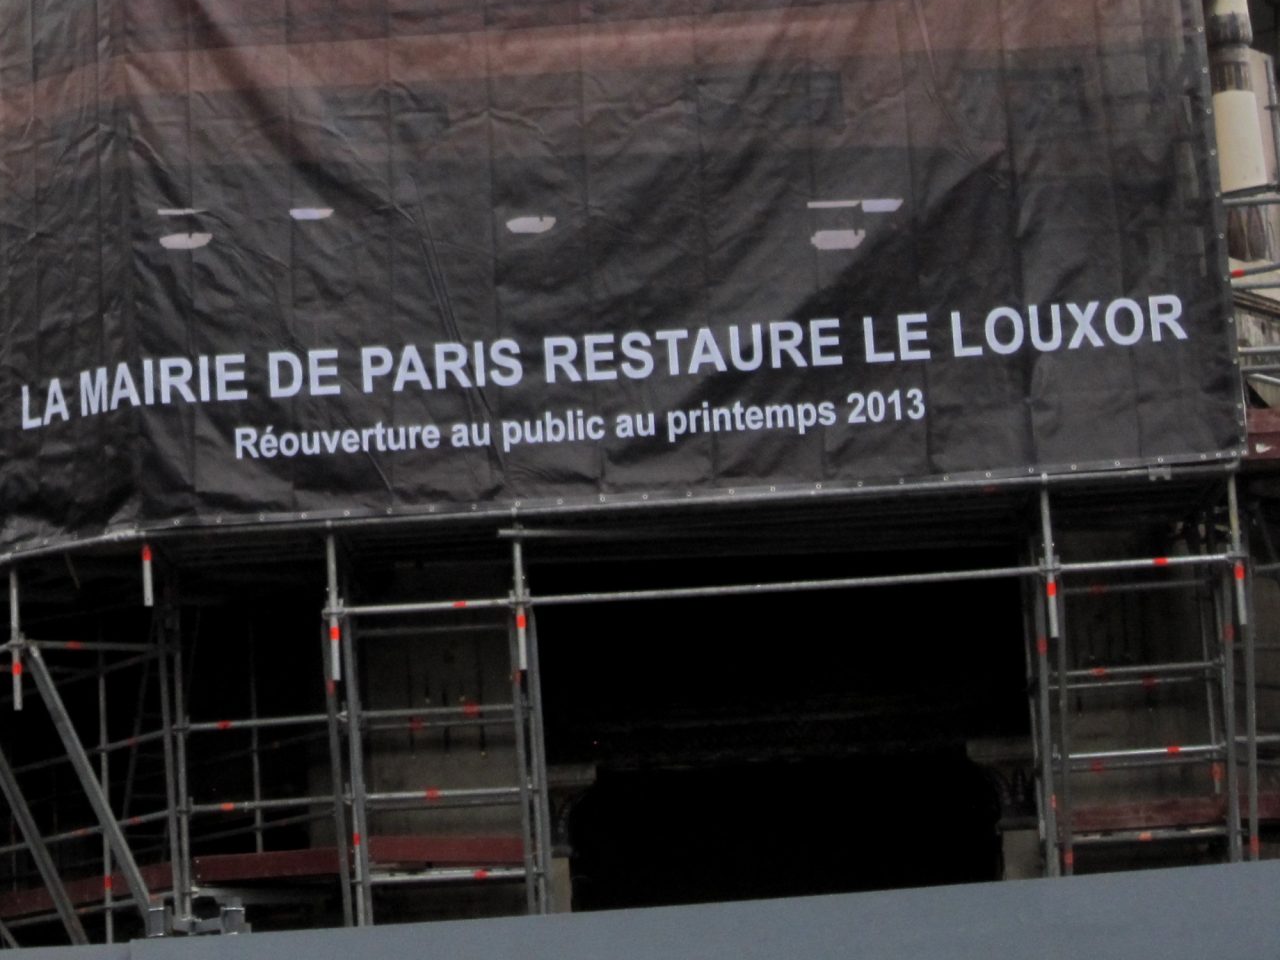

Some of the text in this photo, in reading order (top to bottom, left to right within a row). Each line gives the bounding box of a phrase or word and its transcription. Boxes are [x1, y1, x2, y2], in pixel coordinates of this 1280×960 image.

[22, 294, 1189, 430] LA MAIRIE DE PARIS RESTAURE LE LOUXOR
[234, 387, 927, 460] Réouverture au public au printemps 2013
